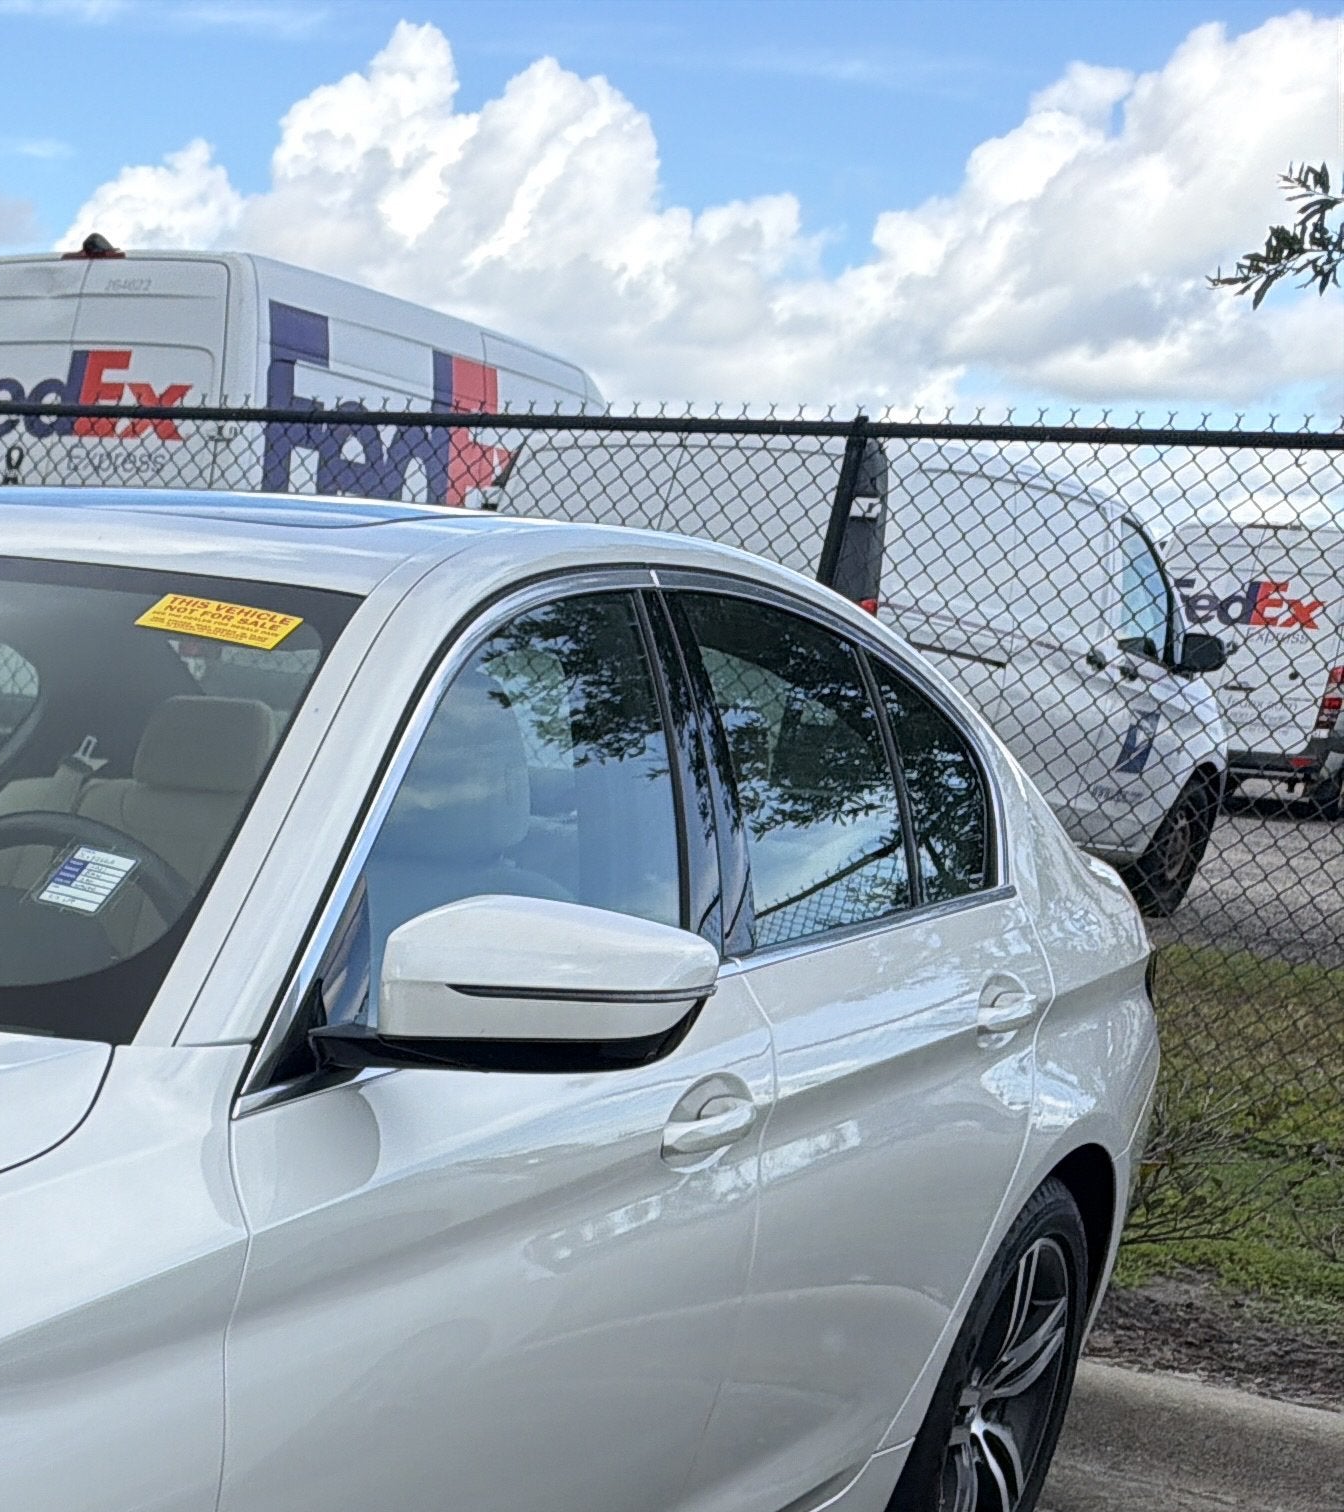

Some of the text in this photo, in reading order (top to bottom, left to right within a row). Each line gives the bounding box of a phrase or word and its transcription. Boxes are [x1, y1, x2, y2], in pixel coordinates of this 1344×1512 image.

[164, 604, 198, 615] NOT
[199, 610, 234, 622] FOR
[237, 618, 281, 631] SALE
[170, 597, 295, 626] THIS VEHICLE
